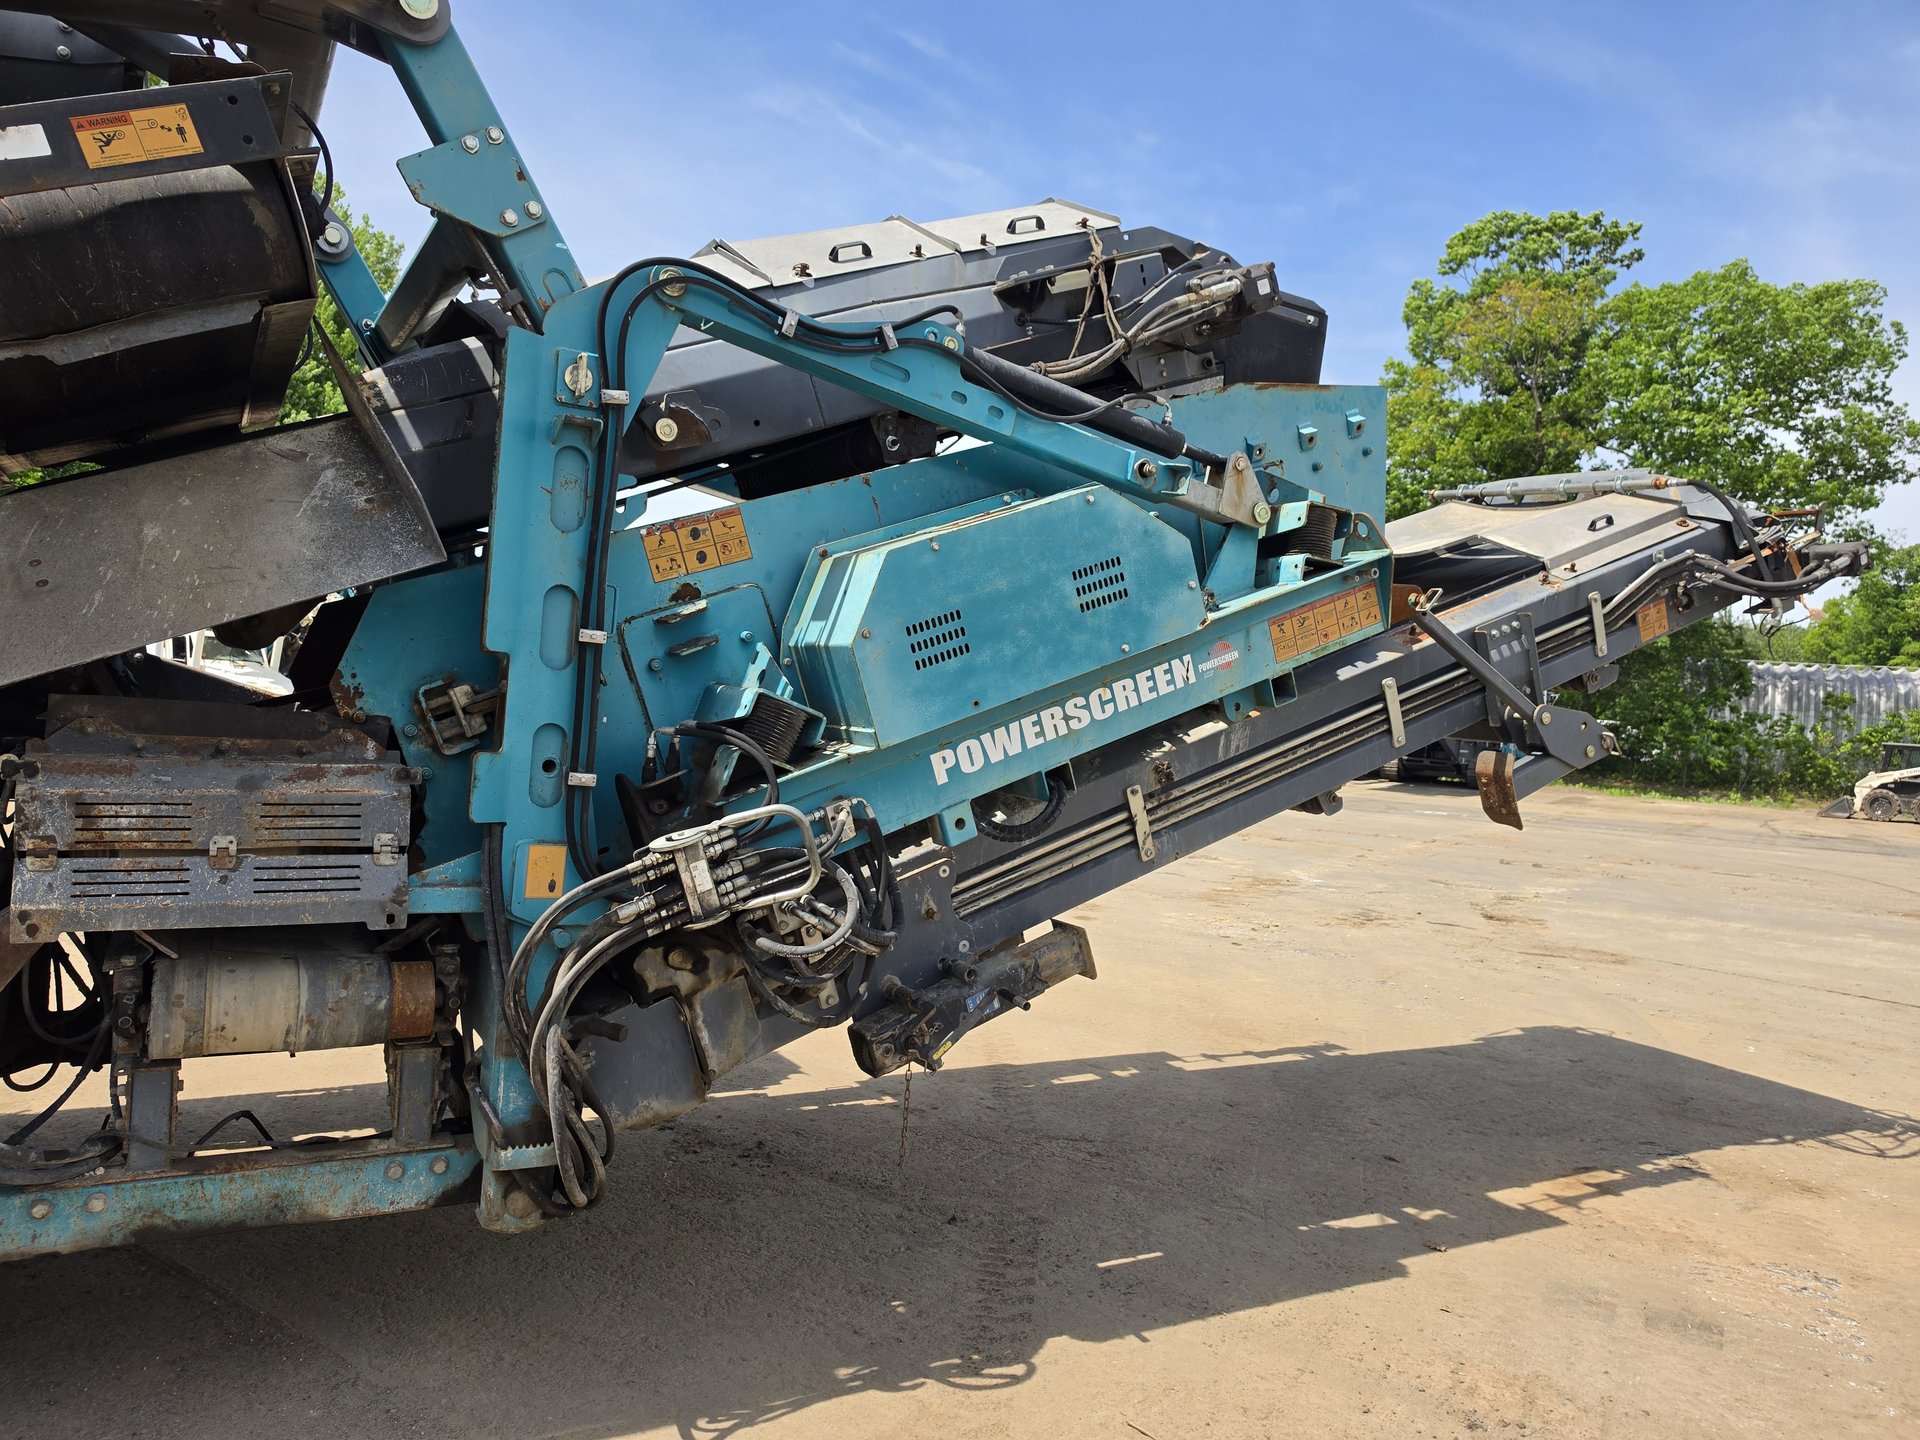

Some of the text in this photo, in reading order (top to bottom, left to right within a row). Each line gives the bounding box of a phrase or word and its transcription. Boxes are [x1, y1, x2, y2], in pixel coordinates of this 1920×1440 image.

[86, 115, 128, 128] WARNING
[1198, 650, 1239, 673] POWERSCREEN
[930, 654, 1196, 786] POWERSCREEN
